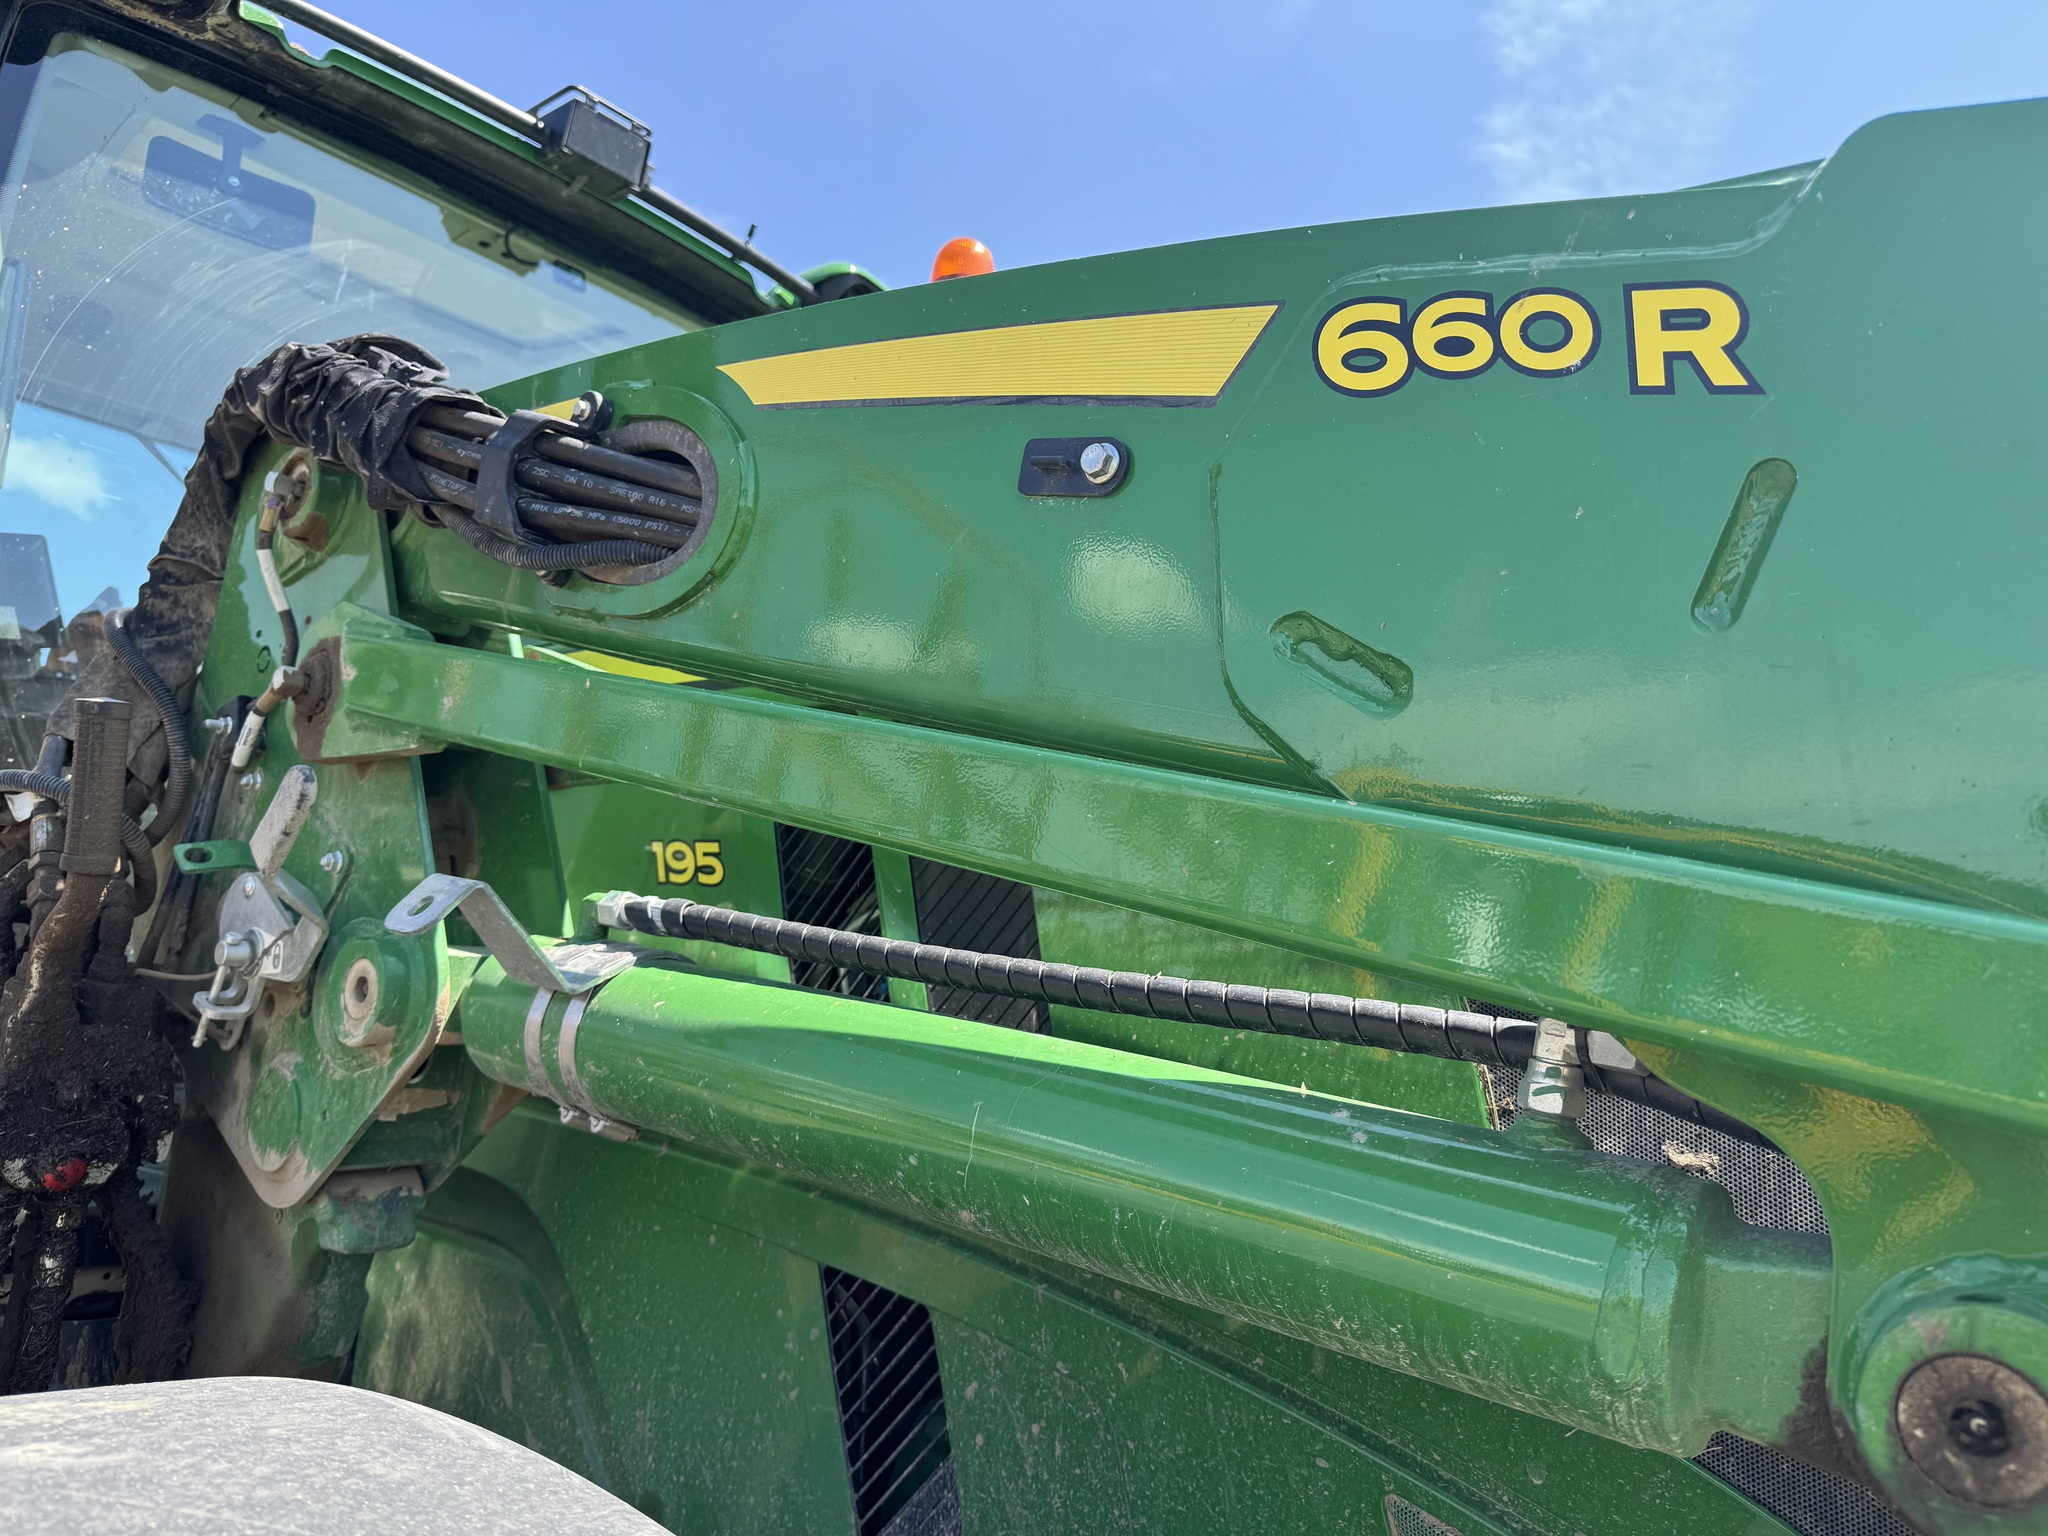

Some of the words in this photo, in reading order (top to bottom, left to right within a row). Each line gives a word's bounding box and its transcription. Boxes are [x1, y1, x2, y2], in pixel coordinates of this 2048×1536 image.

[1312, 286, 1601, 398] 660
[1623, 281, 1767, 395] R
[429, 472, 468, 492] MINETUFF
[532, 466, 551, 478] 2SC
[564, 475, 578, 485] DN
[583, 479, 594, 488] 10
[648, 495, 667, 507] R16
[530, 503, 551, 513] MAX
[587, 511, 606, 521] MPa
[612, 515, 641, 526] (5000
[644, 521, 669, 532] PSI)
[651, 840, 725, 886] 195
